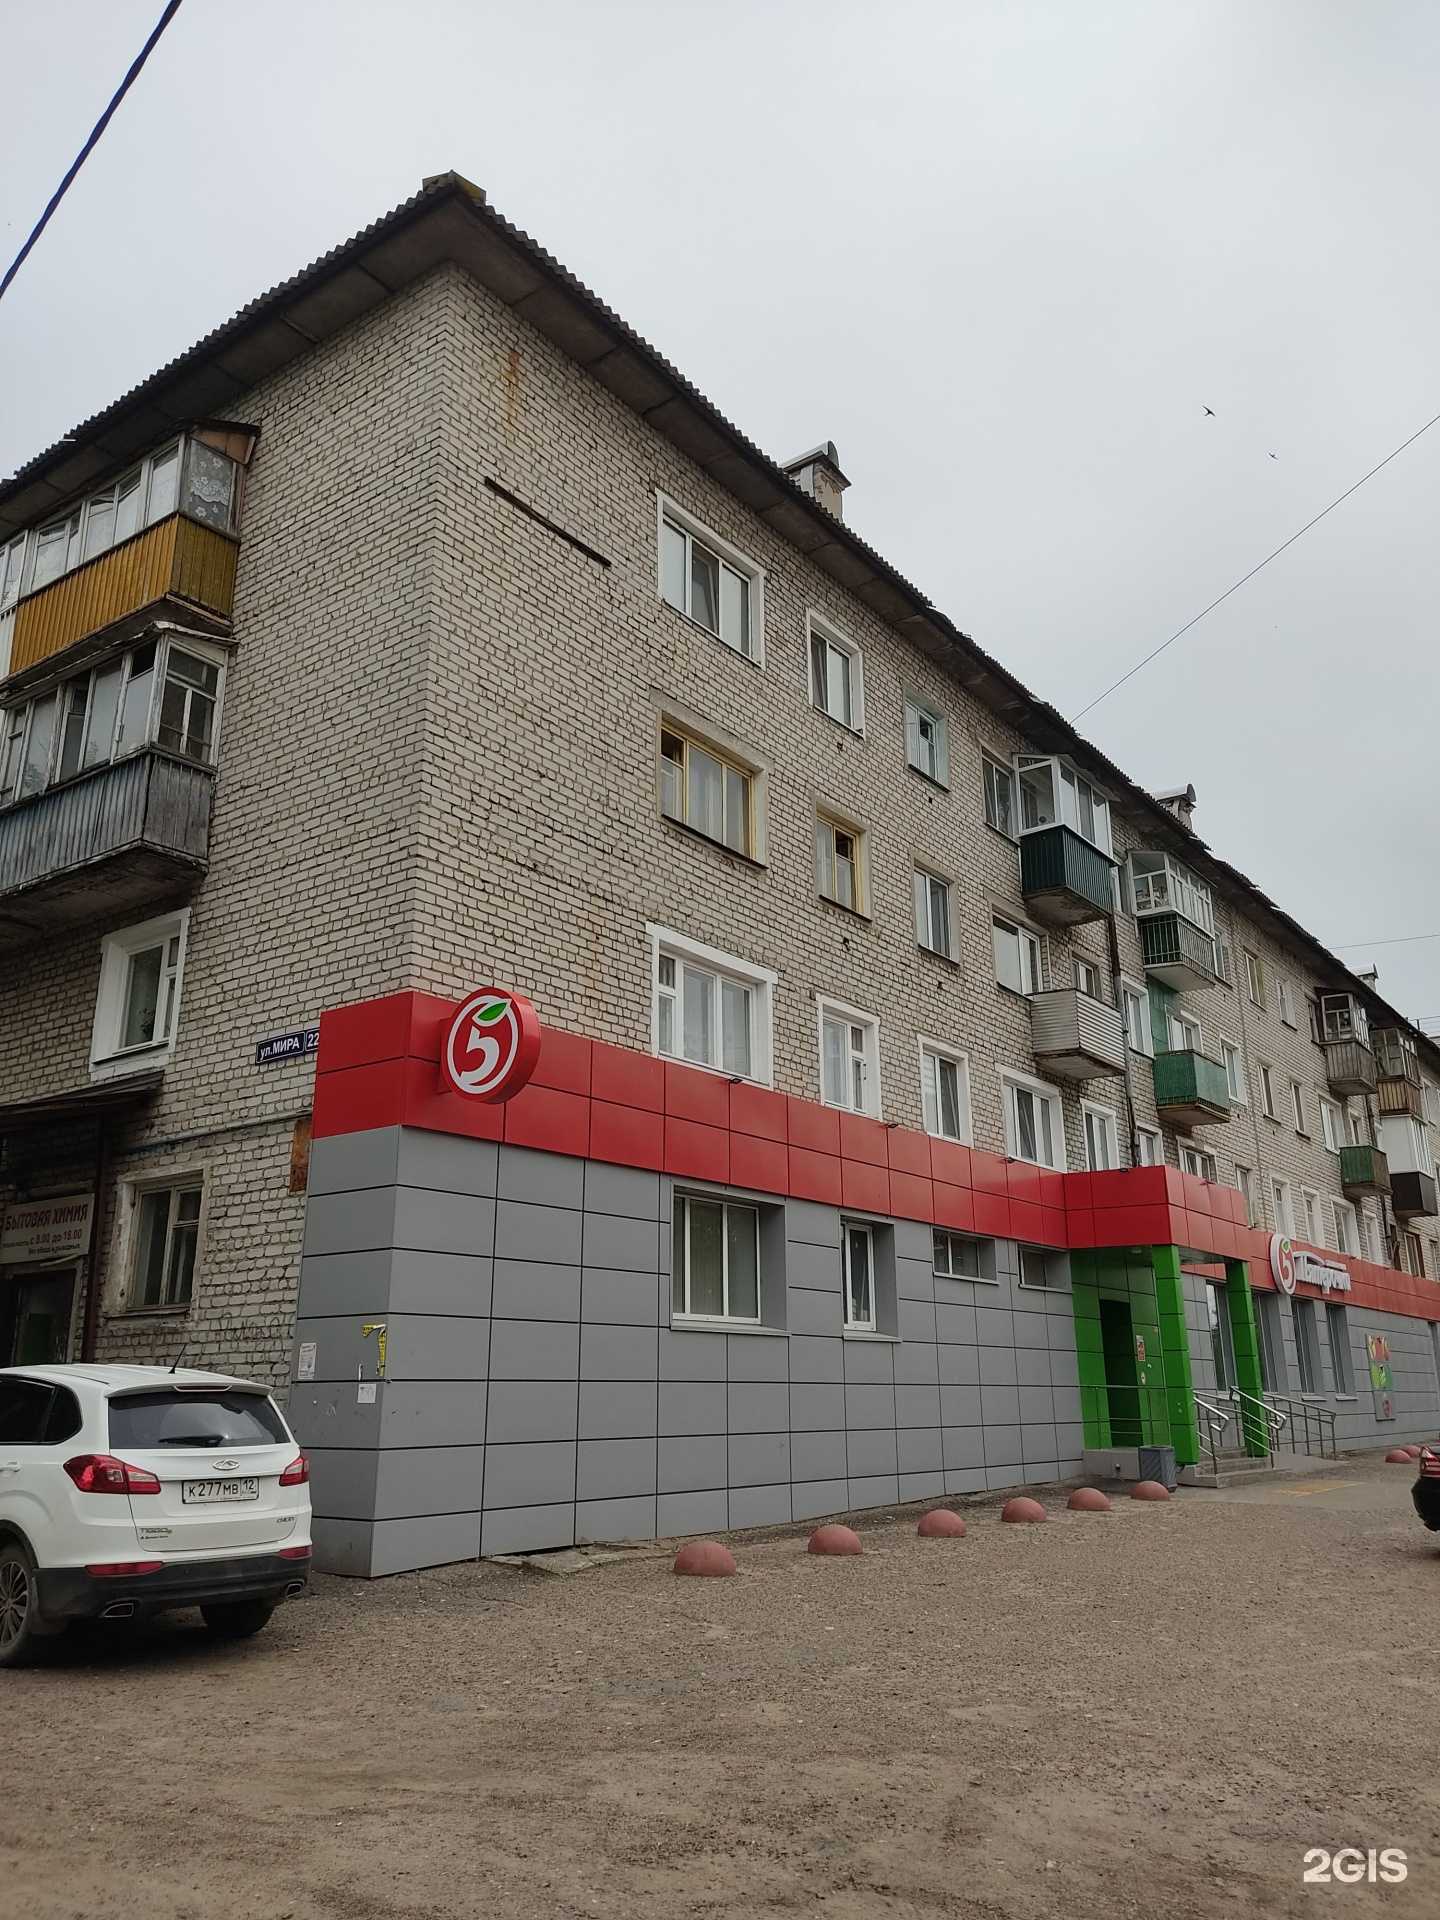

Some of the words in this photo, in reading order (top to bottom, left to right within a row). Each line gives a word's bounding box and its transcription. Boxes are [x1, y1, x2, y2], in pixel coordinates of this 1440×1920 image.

[260, 1037, 300, 1060] ул.МИРА
[5, 1209, 51, 1231] БЫТОВАЯ
[52, 1204, 88, 1225] ХИМИЯ
